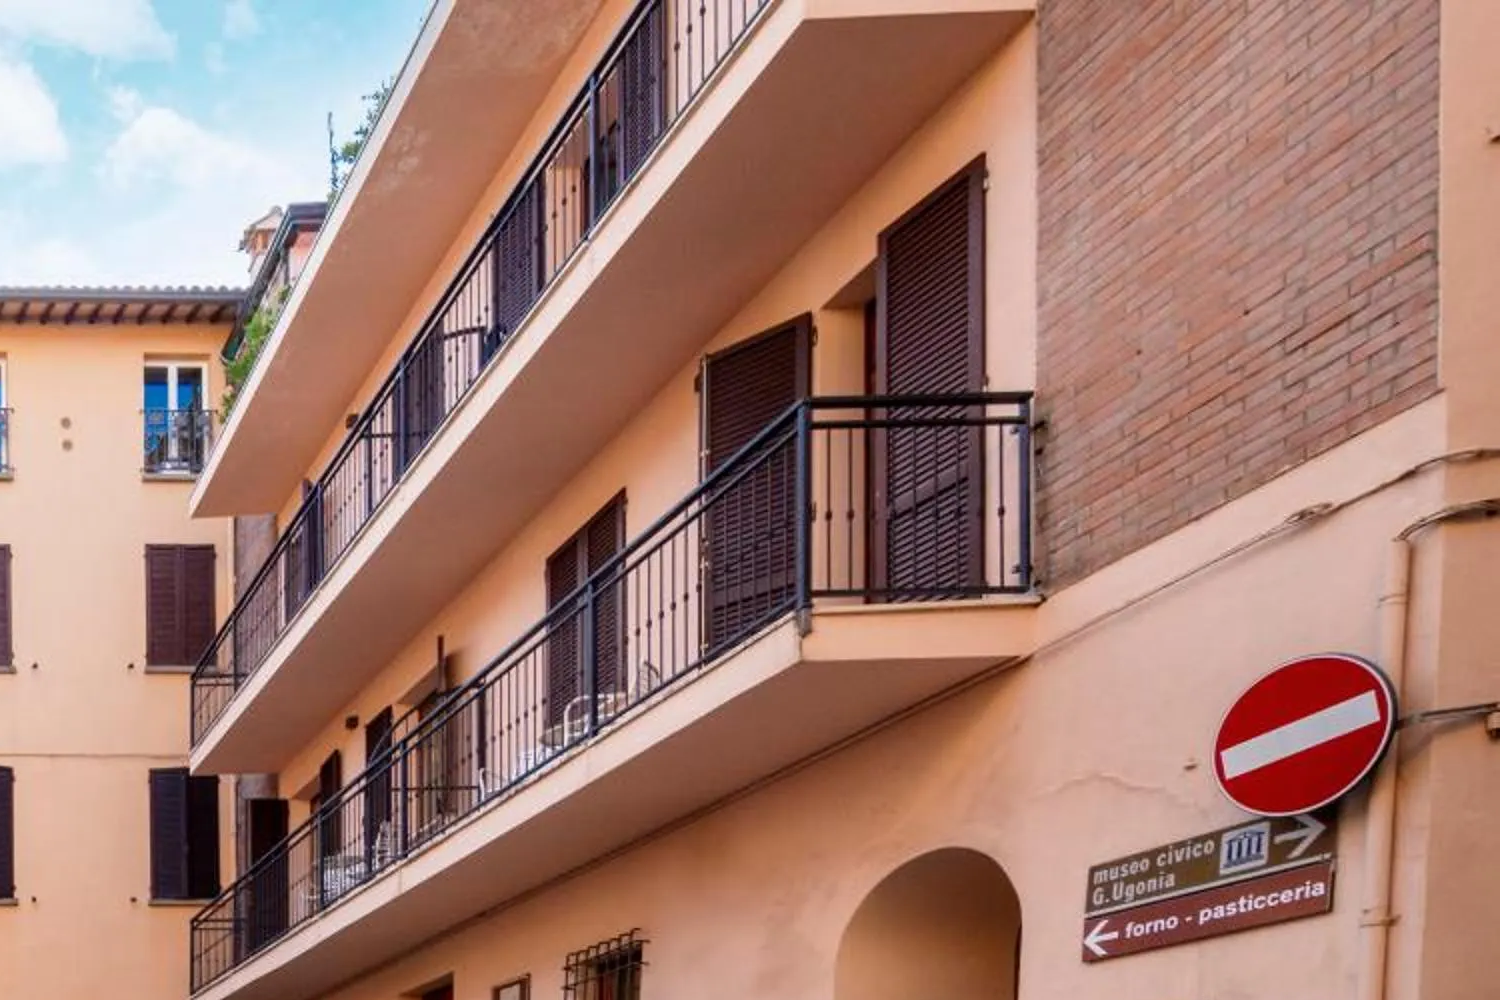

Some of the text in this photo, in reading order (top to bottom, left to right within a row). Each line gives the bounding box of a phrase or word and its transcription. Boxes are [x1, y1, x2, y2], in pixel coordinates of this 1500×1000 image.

[1093, 837, 1215, 884] museo civico
[1125, 913, 1179, 939] forno
[1199, 880, 1325, 925] pasticceria
